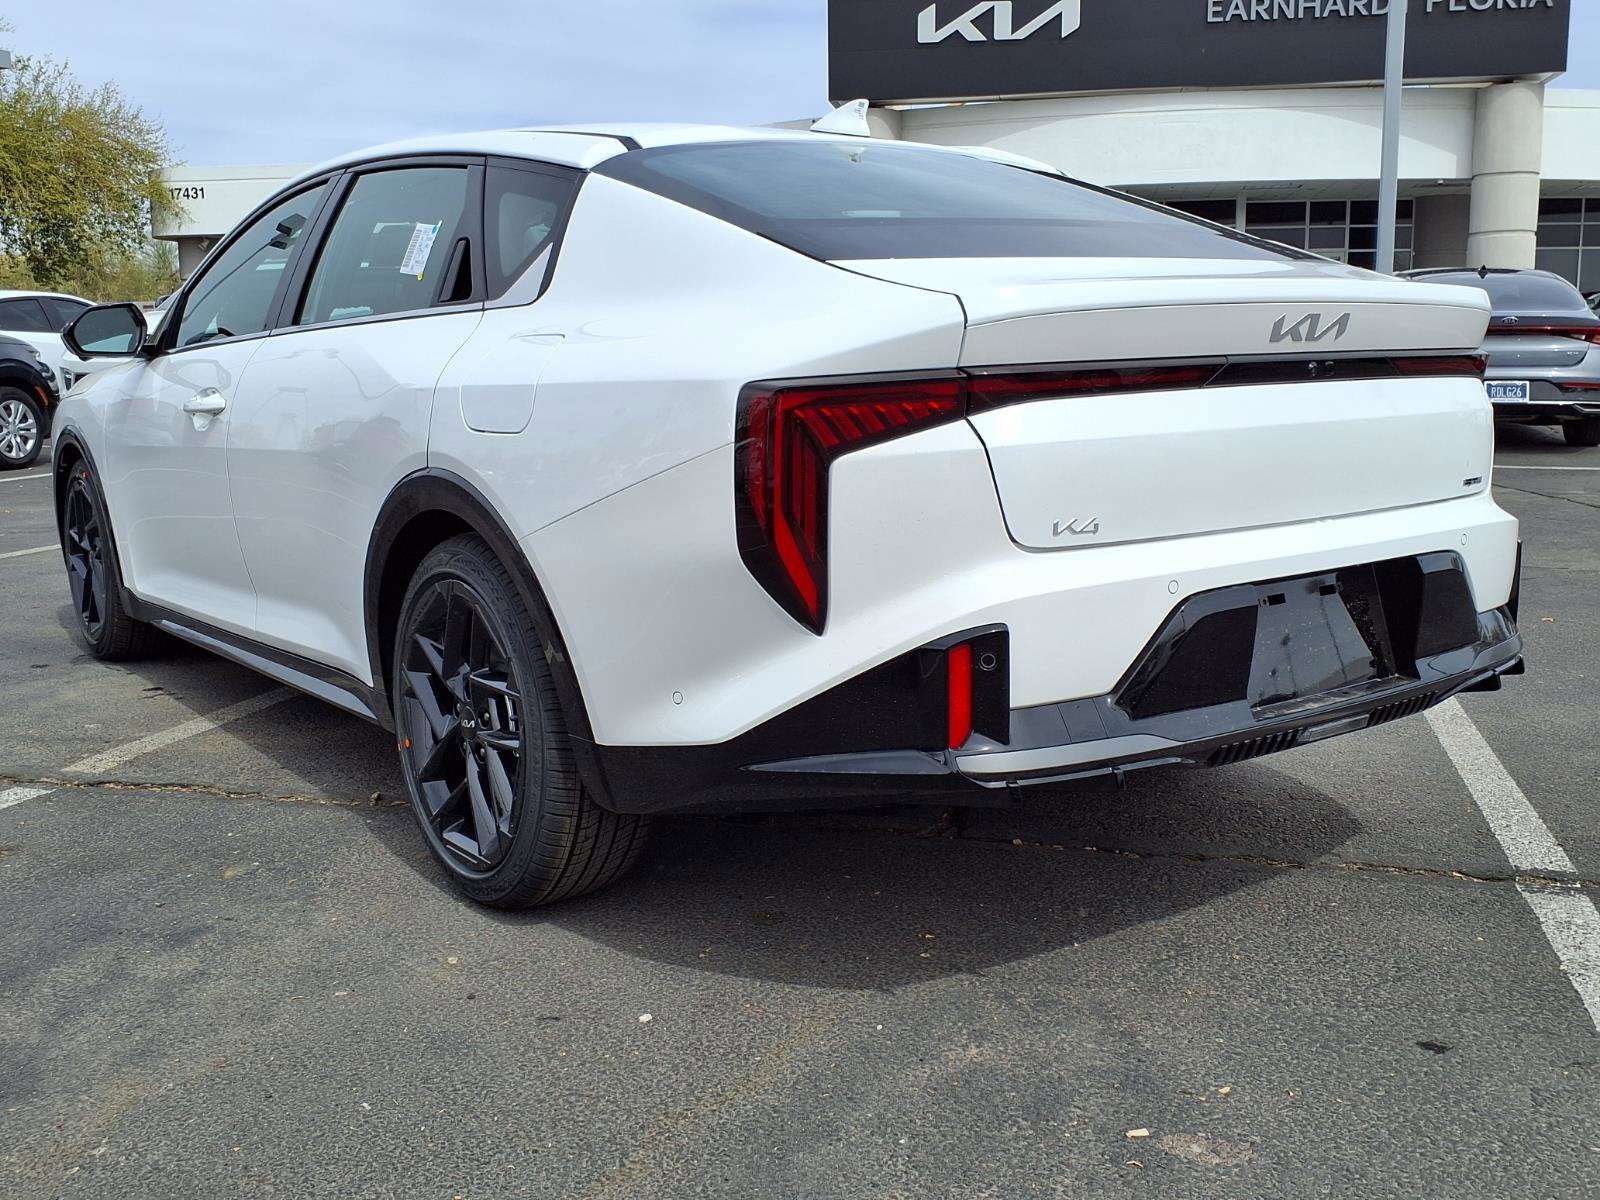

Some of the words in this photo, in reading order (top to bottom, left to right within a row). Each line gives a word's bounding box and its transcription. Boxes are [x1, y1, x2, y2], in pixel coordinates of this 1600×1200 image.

[918, 0, 1081, 43] KIA
[1207, 0, 1408, 22] EARNHARD
[169, 187, 205, 200] 17431
[1269, 312, 1351, 342] KIA
[1491, 386, 1522, 398] RDLG26
[1052, 517, 1099, 537] K4
